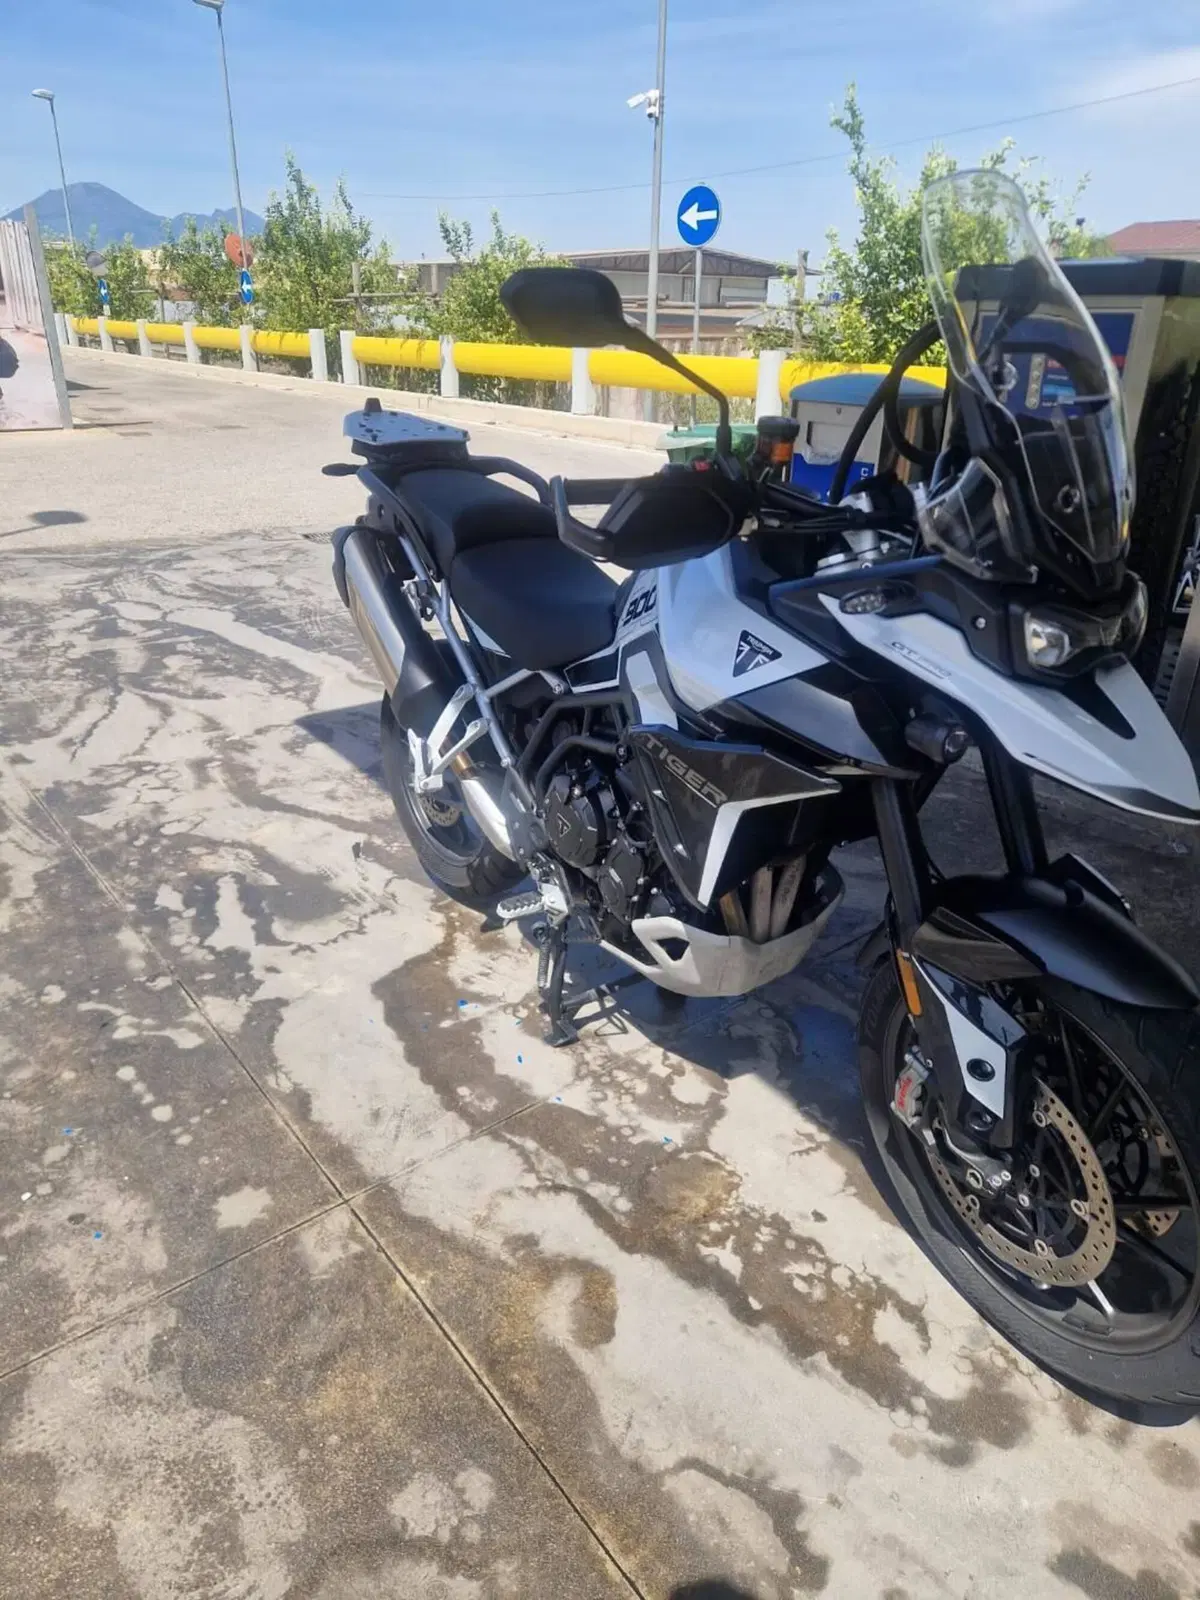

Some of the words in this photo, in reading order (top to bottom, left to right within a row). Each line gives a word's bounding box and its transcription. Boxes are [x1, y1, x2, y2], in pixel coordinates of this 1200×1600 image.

[623, 584, 658, 626] 900
[747, 636, 774, 656] TRIUMPH
[645, 733, 729, 804] TIGER
